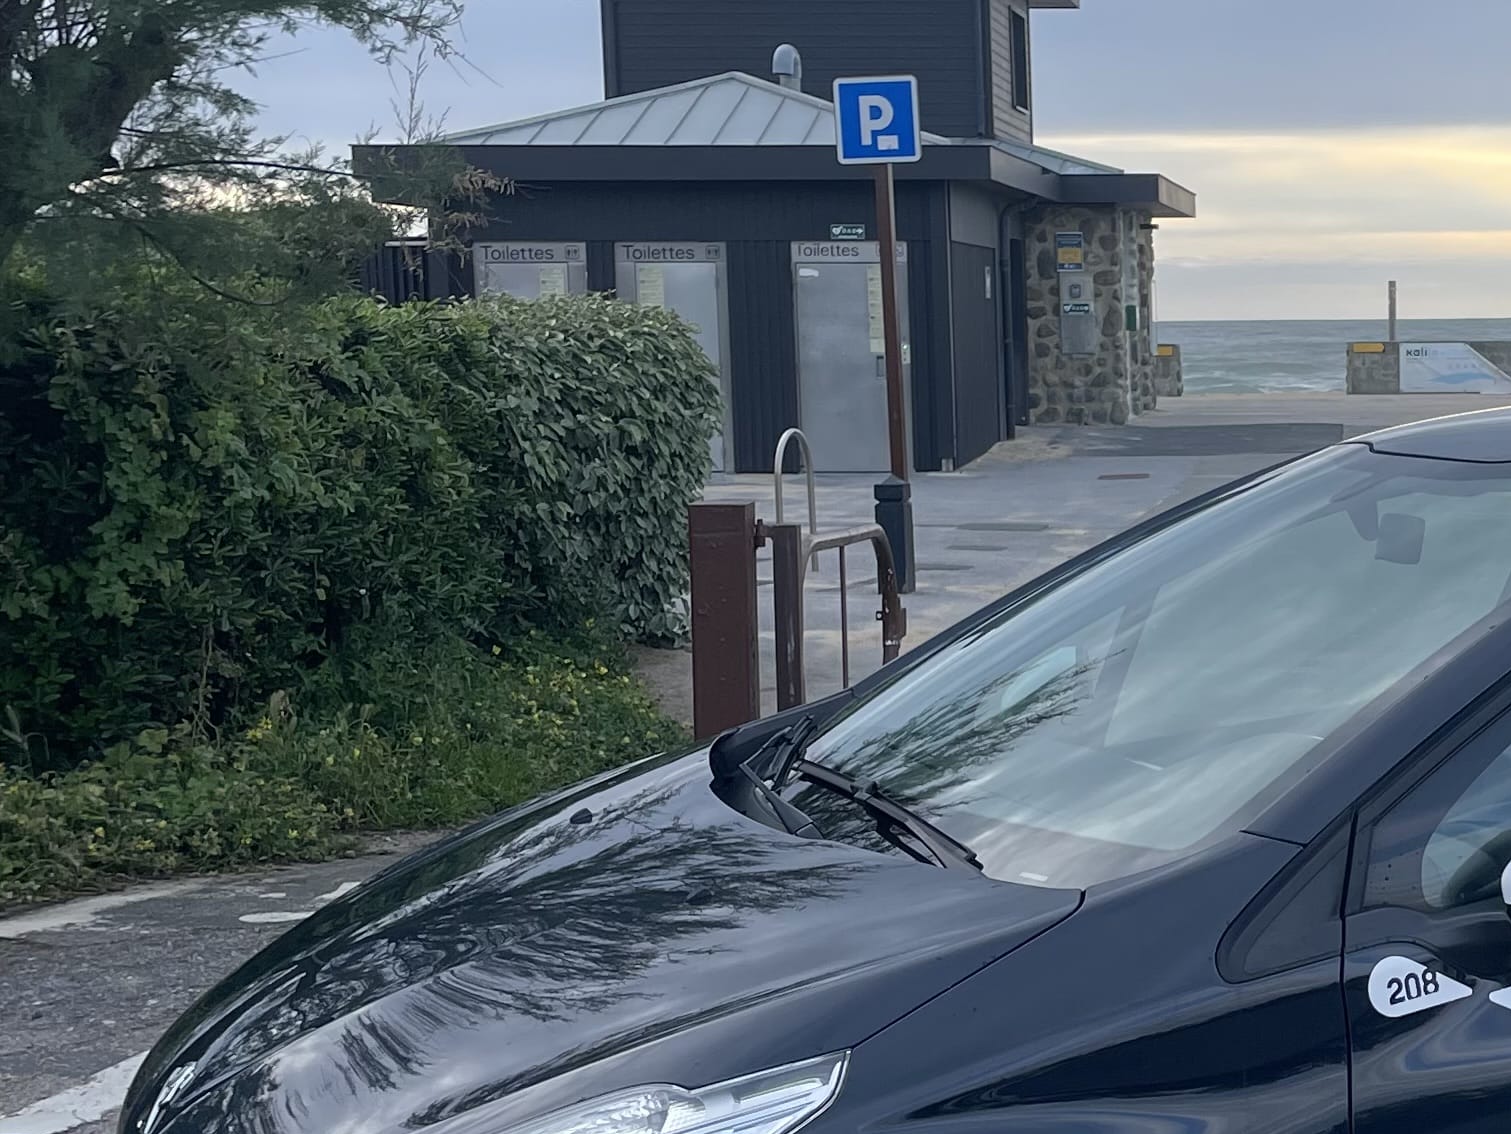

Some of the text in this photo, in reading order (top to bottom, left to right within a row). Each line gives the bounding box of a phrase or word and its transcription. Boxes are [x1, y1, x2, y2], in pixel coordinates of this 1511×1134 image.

[858, 94, 894, 146] P
[480, 245, 554, 260] Toilettes
[622, 244, 695, 260] Toilettes
[1386, 969, 1440, 1006] 208
